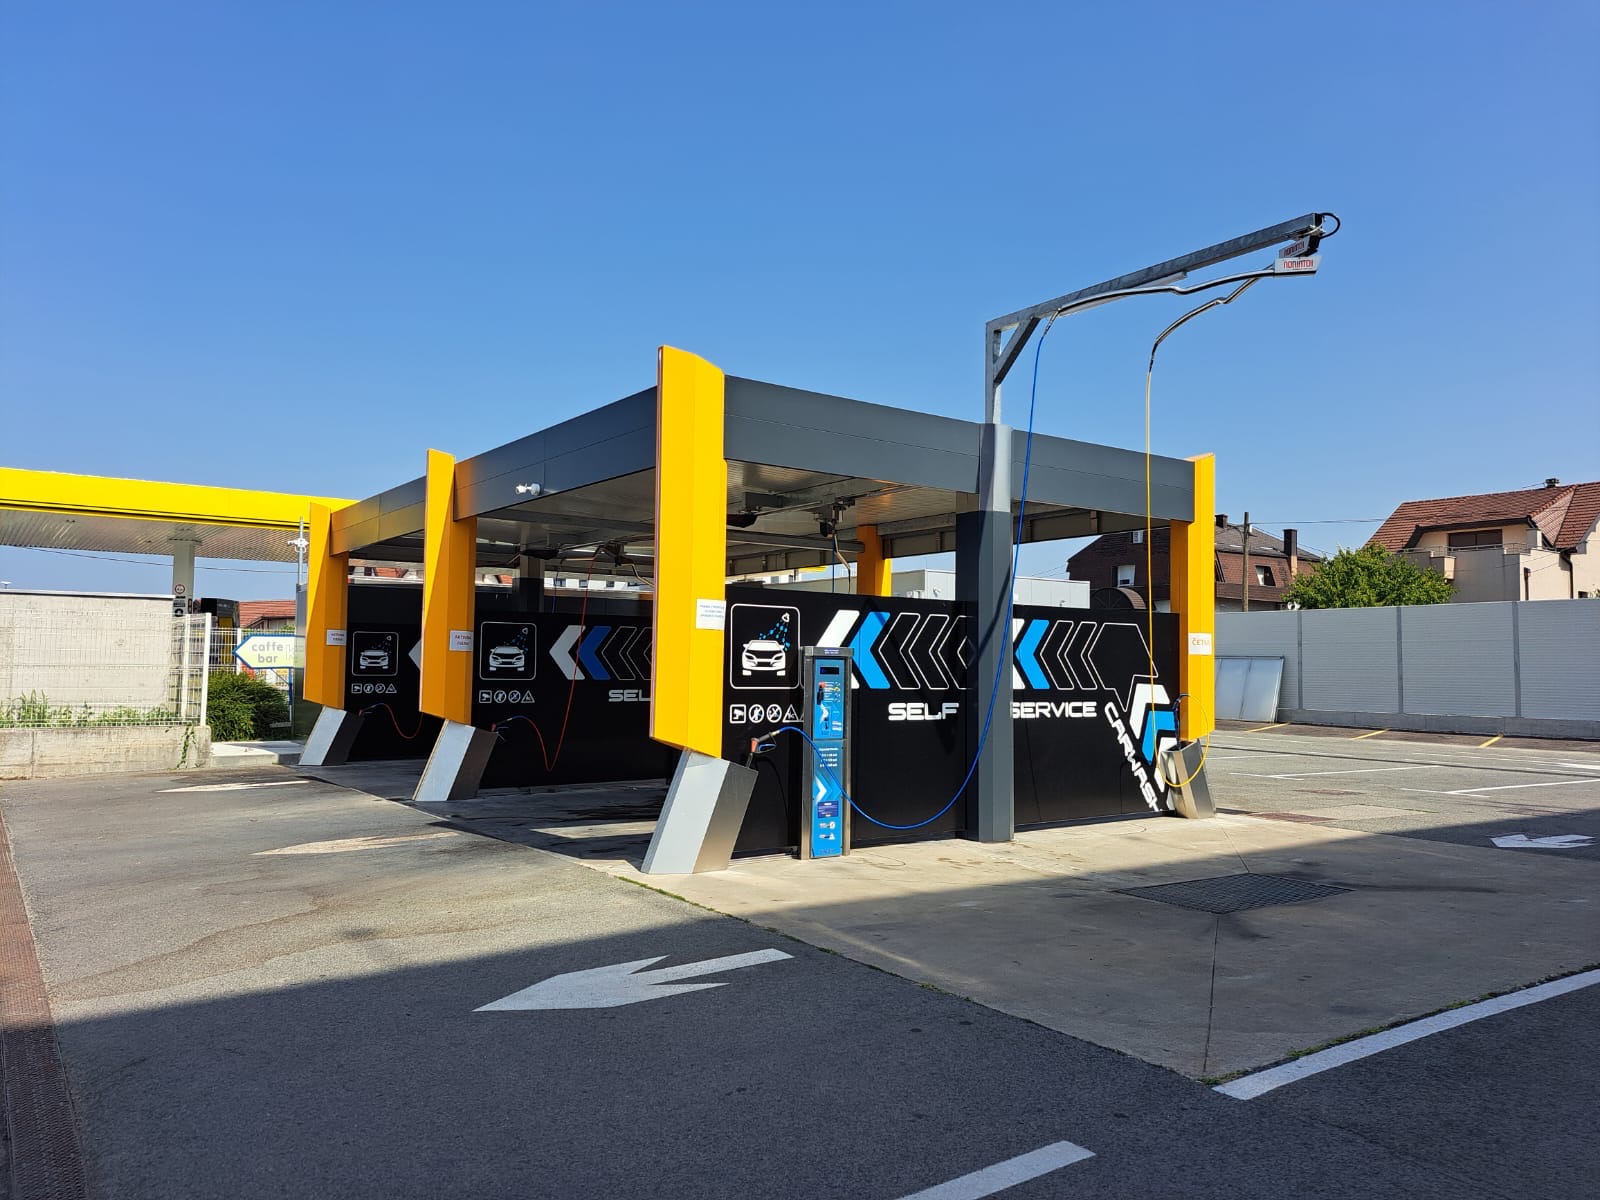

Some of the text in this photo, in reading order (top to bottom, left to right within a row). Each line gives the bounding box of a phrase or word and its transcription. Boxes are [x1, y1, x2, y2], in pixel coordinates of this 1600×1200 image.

[251, 641, 284, 652] caffe
[257, 653, 278, 663] bar
[608, 689, 652, 702] SEL
[888, 702, 959, 720] SELF
